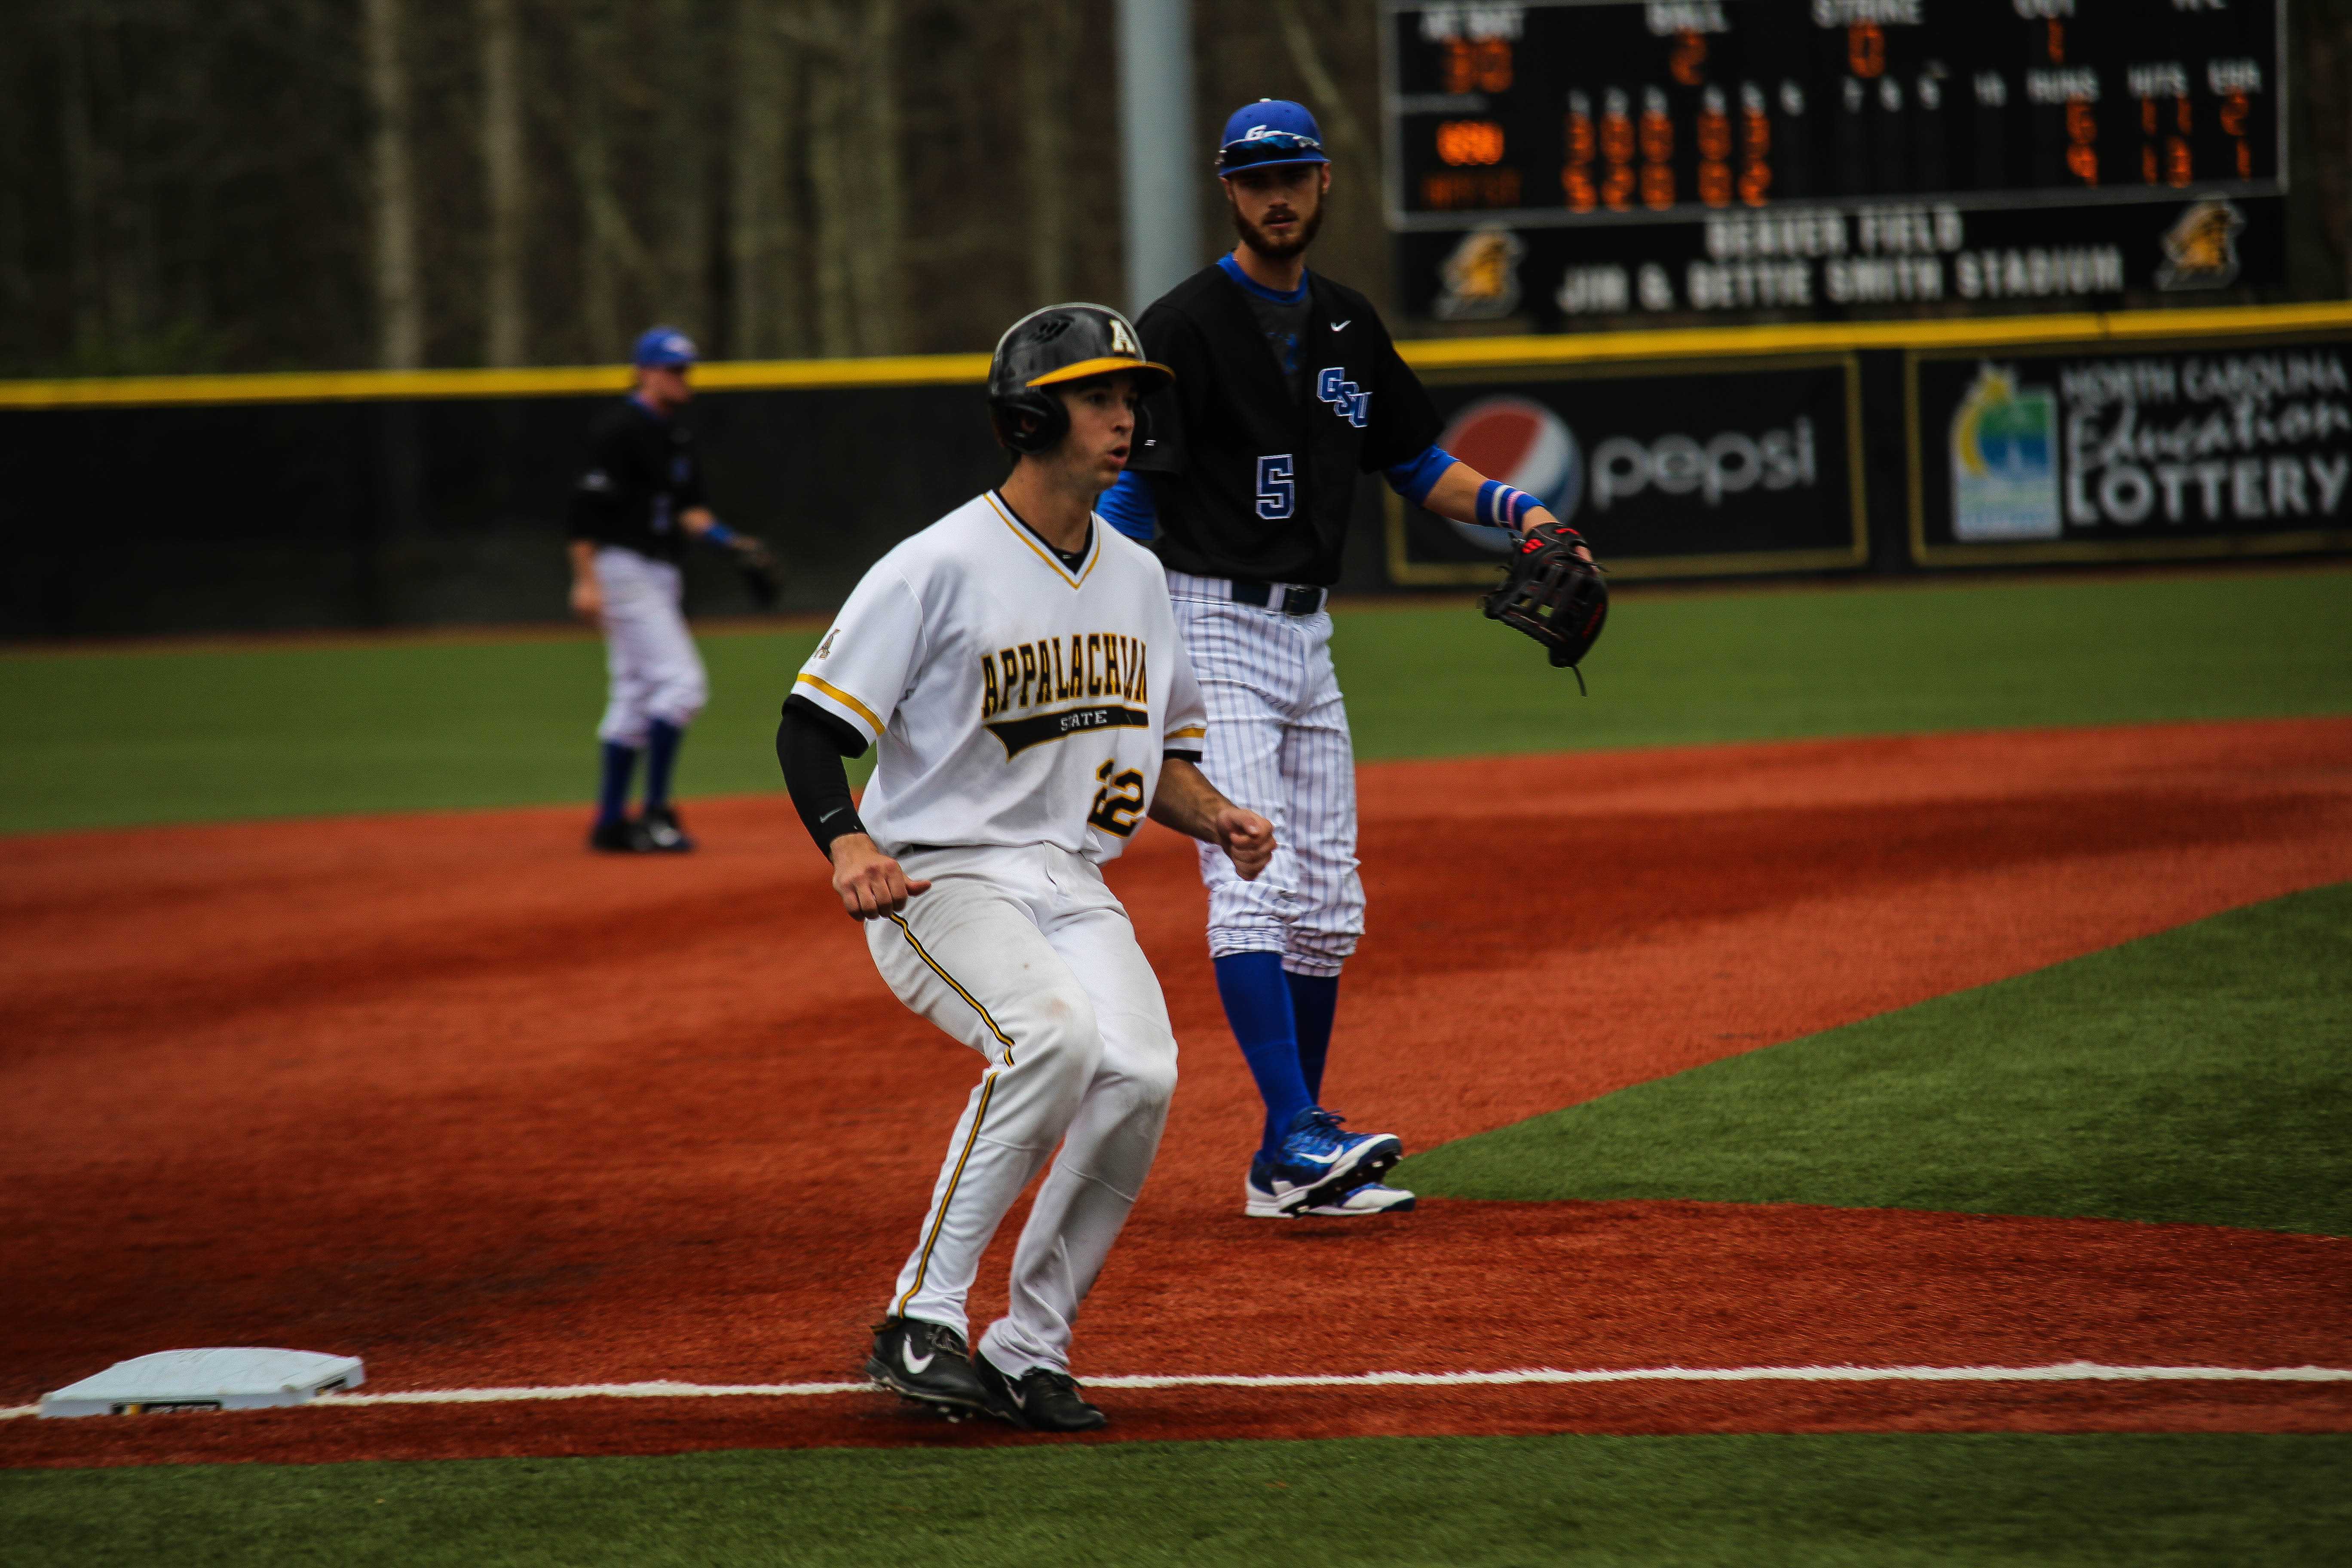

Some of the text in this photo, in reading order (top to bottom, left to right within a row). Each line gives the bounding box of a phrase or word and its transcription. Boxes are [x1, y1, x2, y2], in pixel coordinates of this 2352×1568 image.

[1850, 19, 1885, 78] 0
[2048, 16, 2063, 63] 1
[1858, 201, 1963, 254] FIELD
[1557, 263, 1629, 313] JIM
[1638, 263, 1675, 311] &
[1824, 255, 1945, 304] SMITH
[1956, 246, 2125, 298] STADIUM
[1109, 318, 1136, 354] A
[1317, 367, 1373, 427] GSU
[2062, 350, 2350, 402] NORTH CAROLINA
[1256, 454, 1295, 519] 5
[1591, 415, 1816, 511] pepsi
[2066, 453, 2350, 526] LOTTERY
